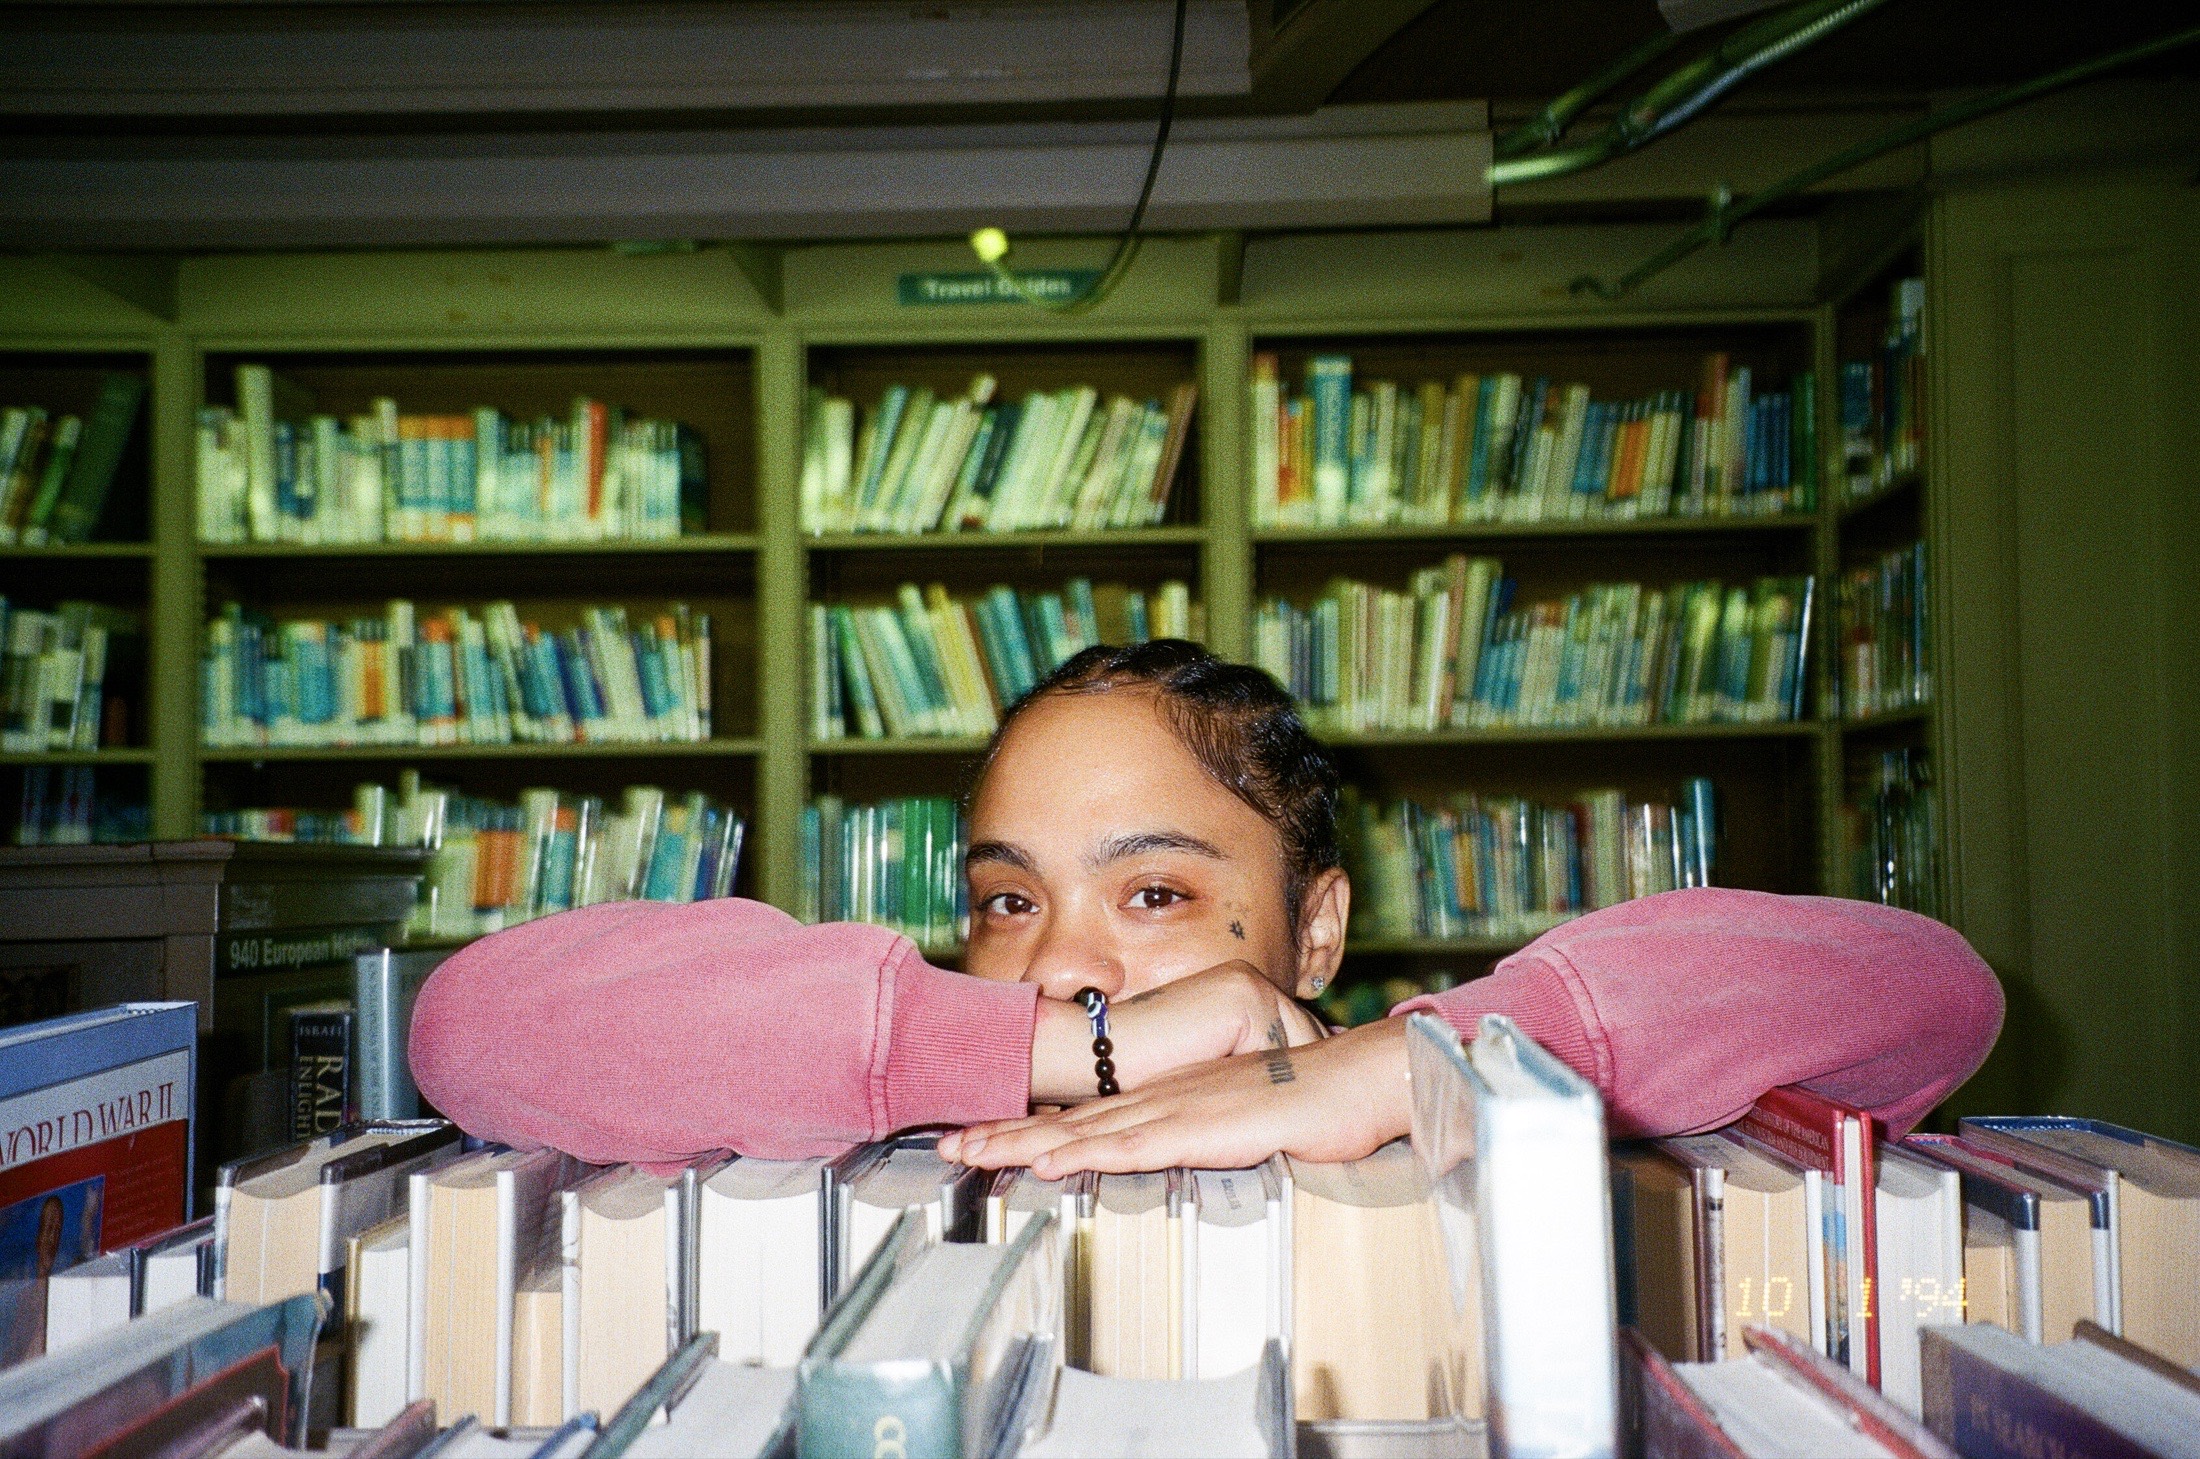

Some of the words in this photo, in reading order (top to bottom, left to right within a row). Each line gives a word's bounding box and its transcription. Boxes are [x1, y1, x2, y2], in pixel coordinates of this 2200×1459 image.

[924, 278, 991, 299] Travel
[230, 938, 259, 970] 940
[262, 937, 330, 969] European
[98, 1089, 152, 1136] WAR
[159, 1082, 175, 1120] II
